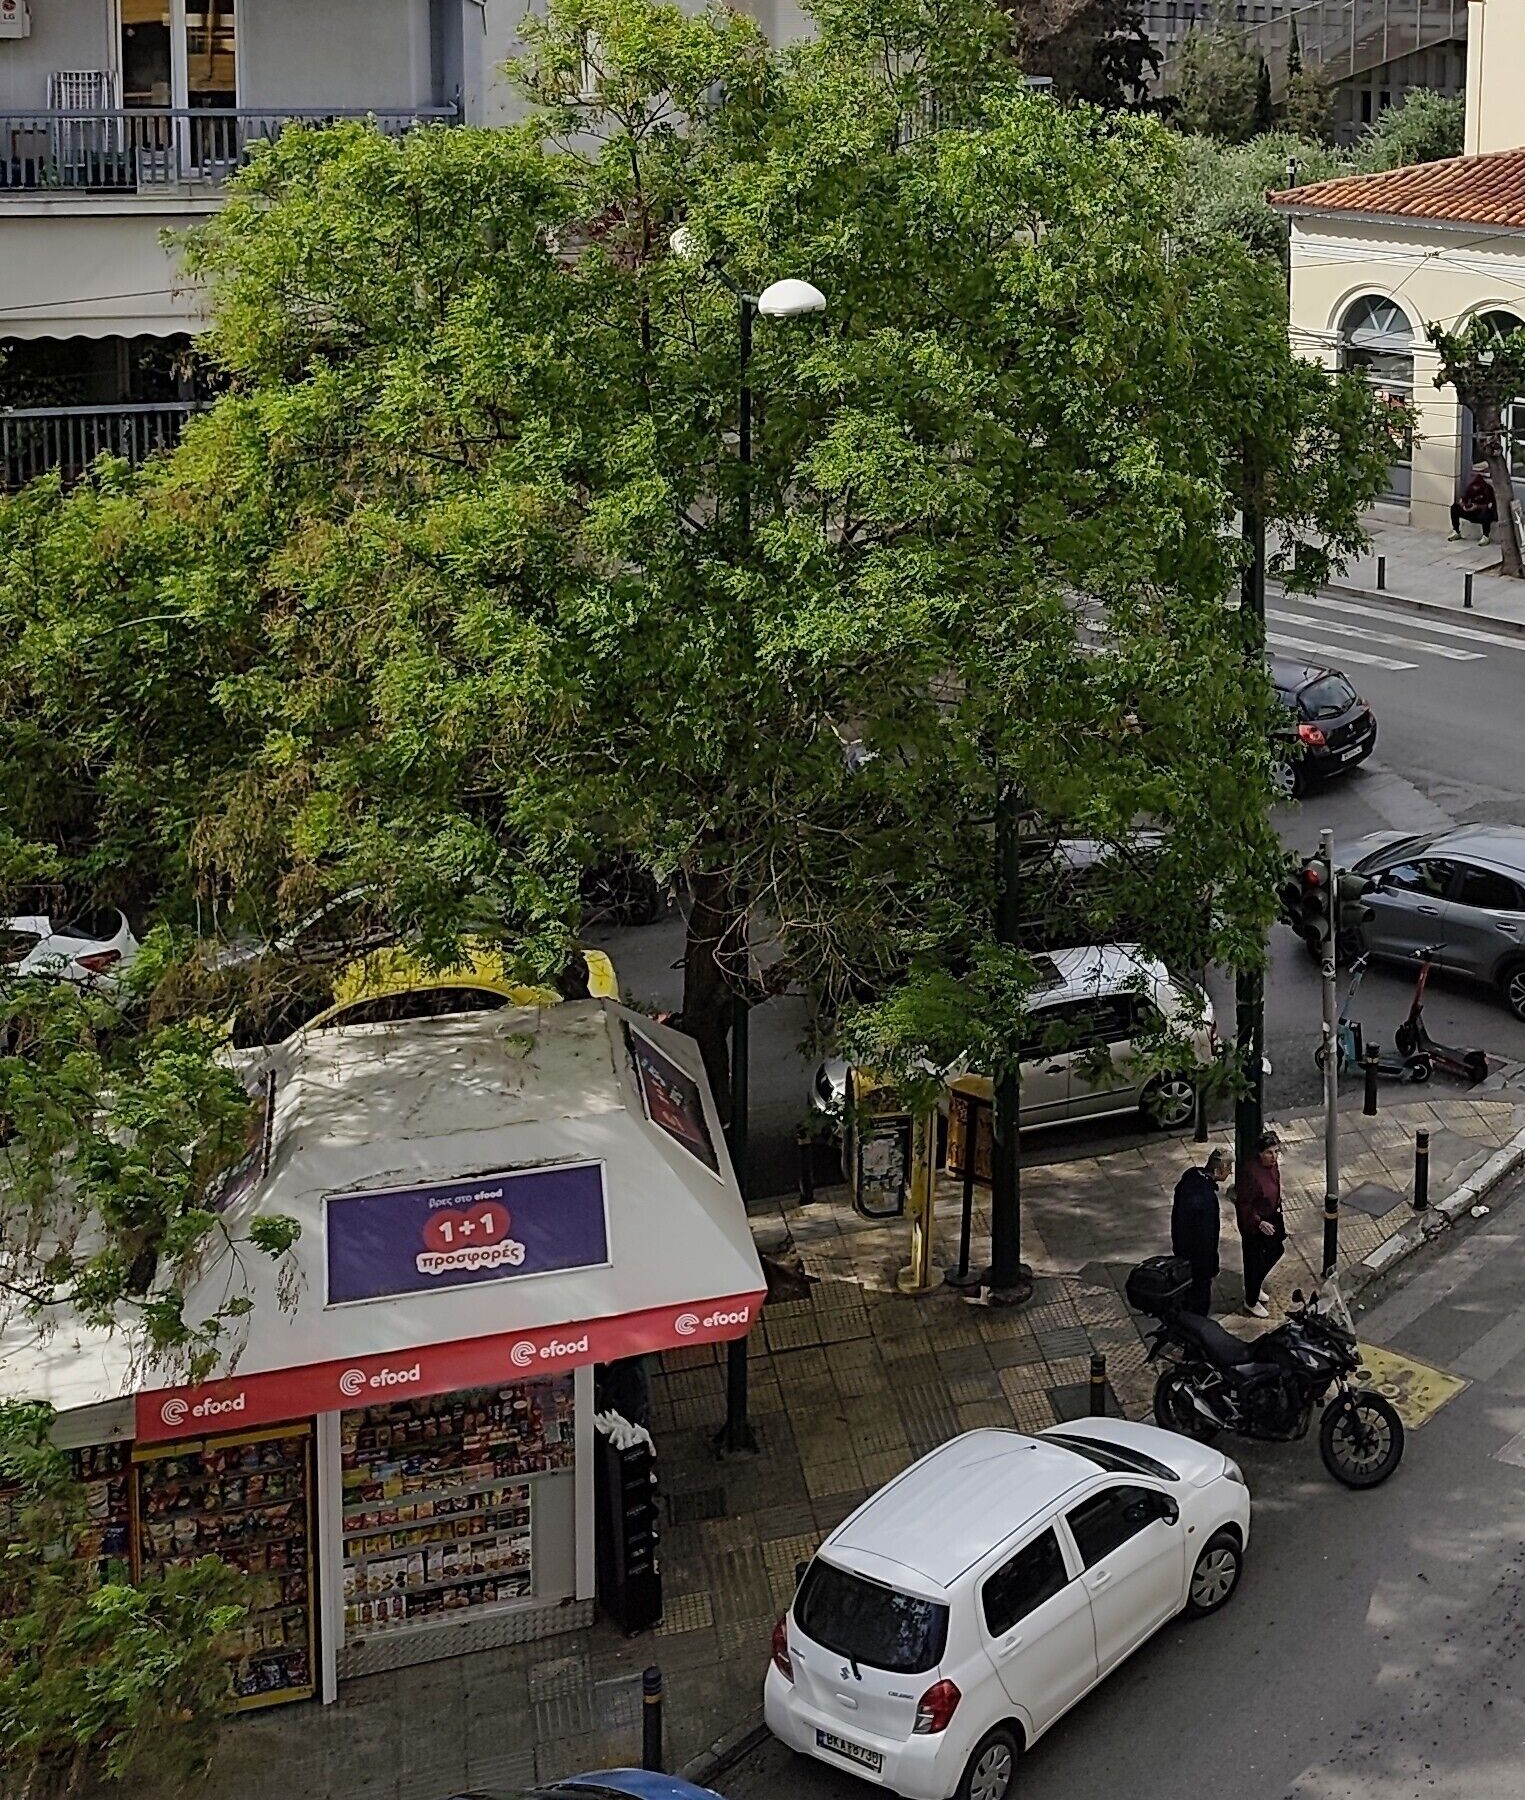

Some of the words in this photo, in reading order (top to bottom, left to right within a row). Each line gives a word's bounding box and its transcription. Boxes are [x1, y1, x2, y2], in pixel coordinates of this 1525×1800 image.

[429, 1198, 453, 1209] βρες
[454, 1195, 472, 1204] στο
[474, 1188, 503, 1201] efood
[421, 1244, 520, 1266] προσφορές
[702, 1306, 749, 1328] efood
[539, 1335, 589, 1359] efood
[369, 1363, 421, 1388] efood
[192, 1392, 246, 1417] efood
